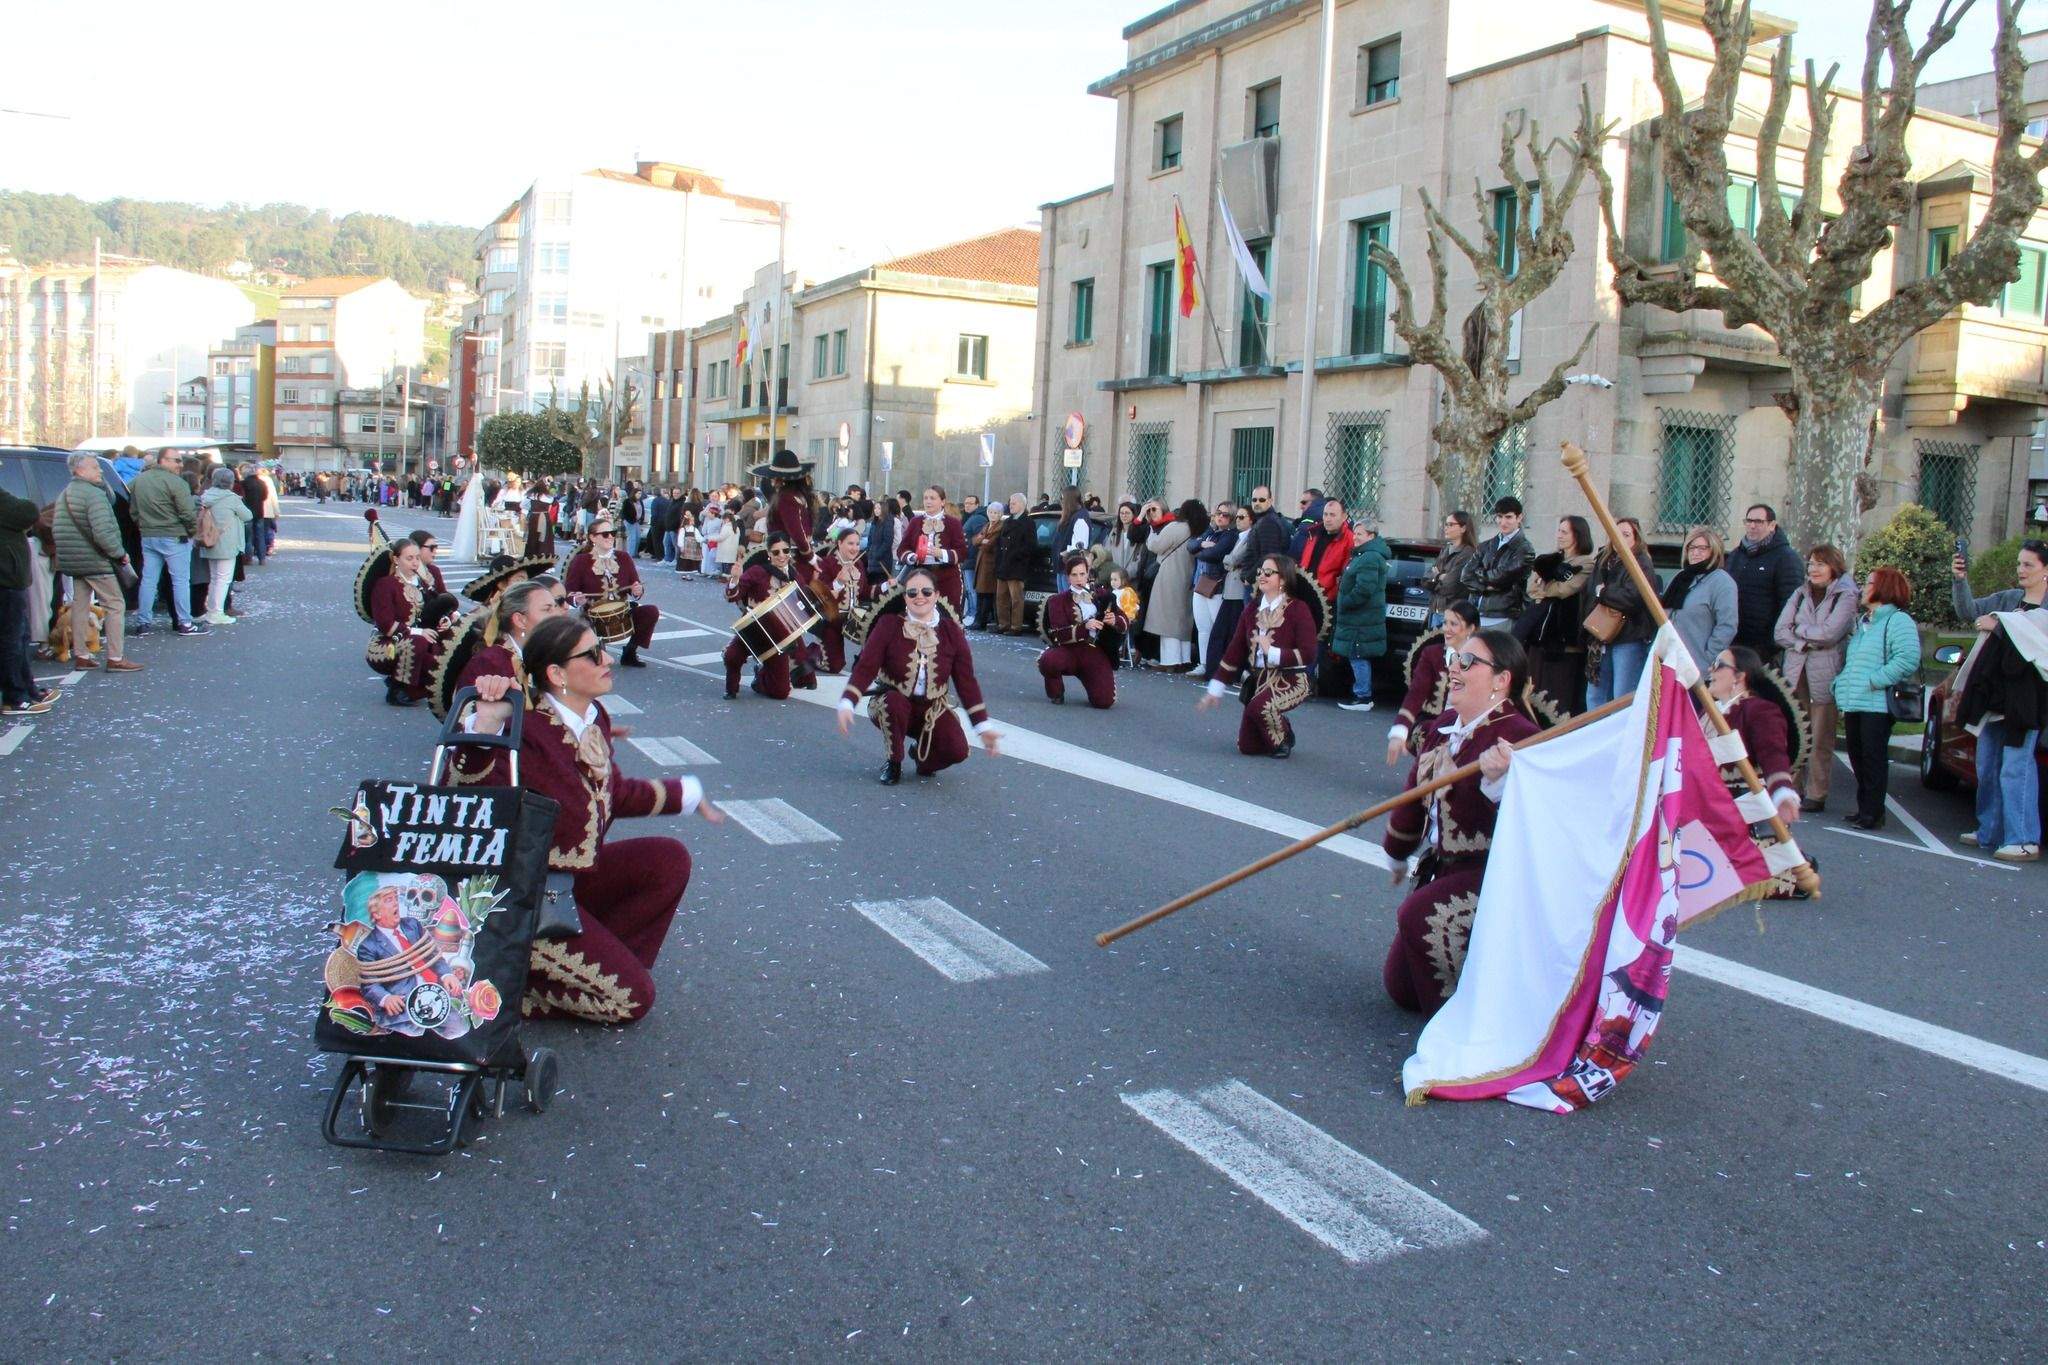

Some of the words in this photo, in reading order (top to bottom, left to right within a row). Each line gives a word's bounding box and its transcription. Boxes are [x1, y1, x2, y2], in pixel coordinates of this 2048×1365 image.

[1389, 606, 1416, 618] 4966
[386, 783, 494, 829] TINTA
[392, 828, 509, 866] FEMIA
